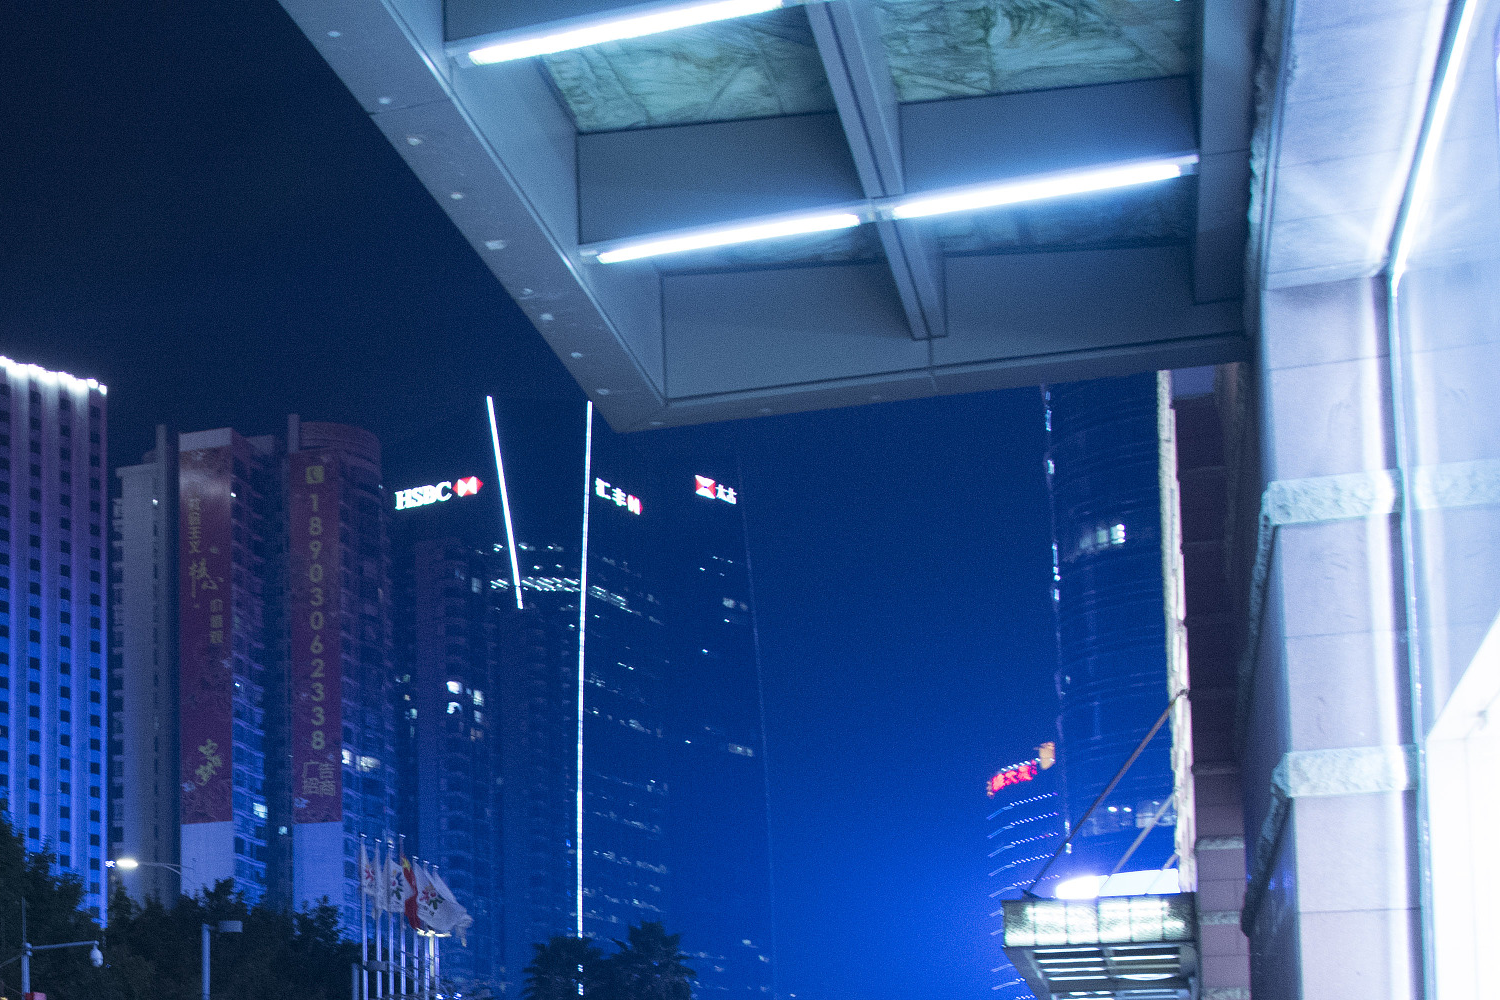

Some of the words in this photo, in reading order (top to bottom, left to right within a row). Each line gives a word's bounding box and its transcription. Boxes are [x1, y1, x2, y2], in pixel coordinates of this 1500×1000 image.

[395, 480, 453, 510] HSBC
[595, 477, 627, 507] 汇丰
[308, 493, 326, 750] 18903062338
